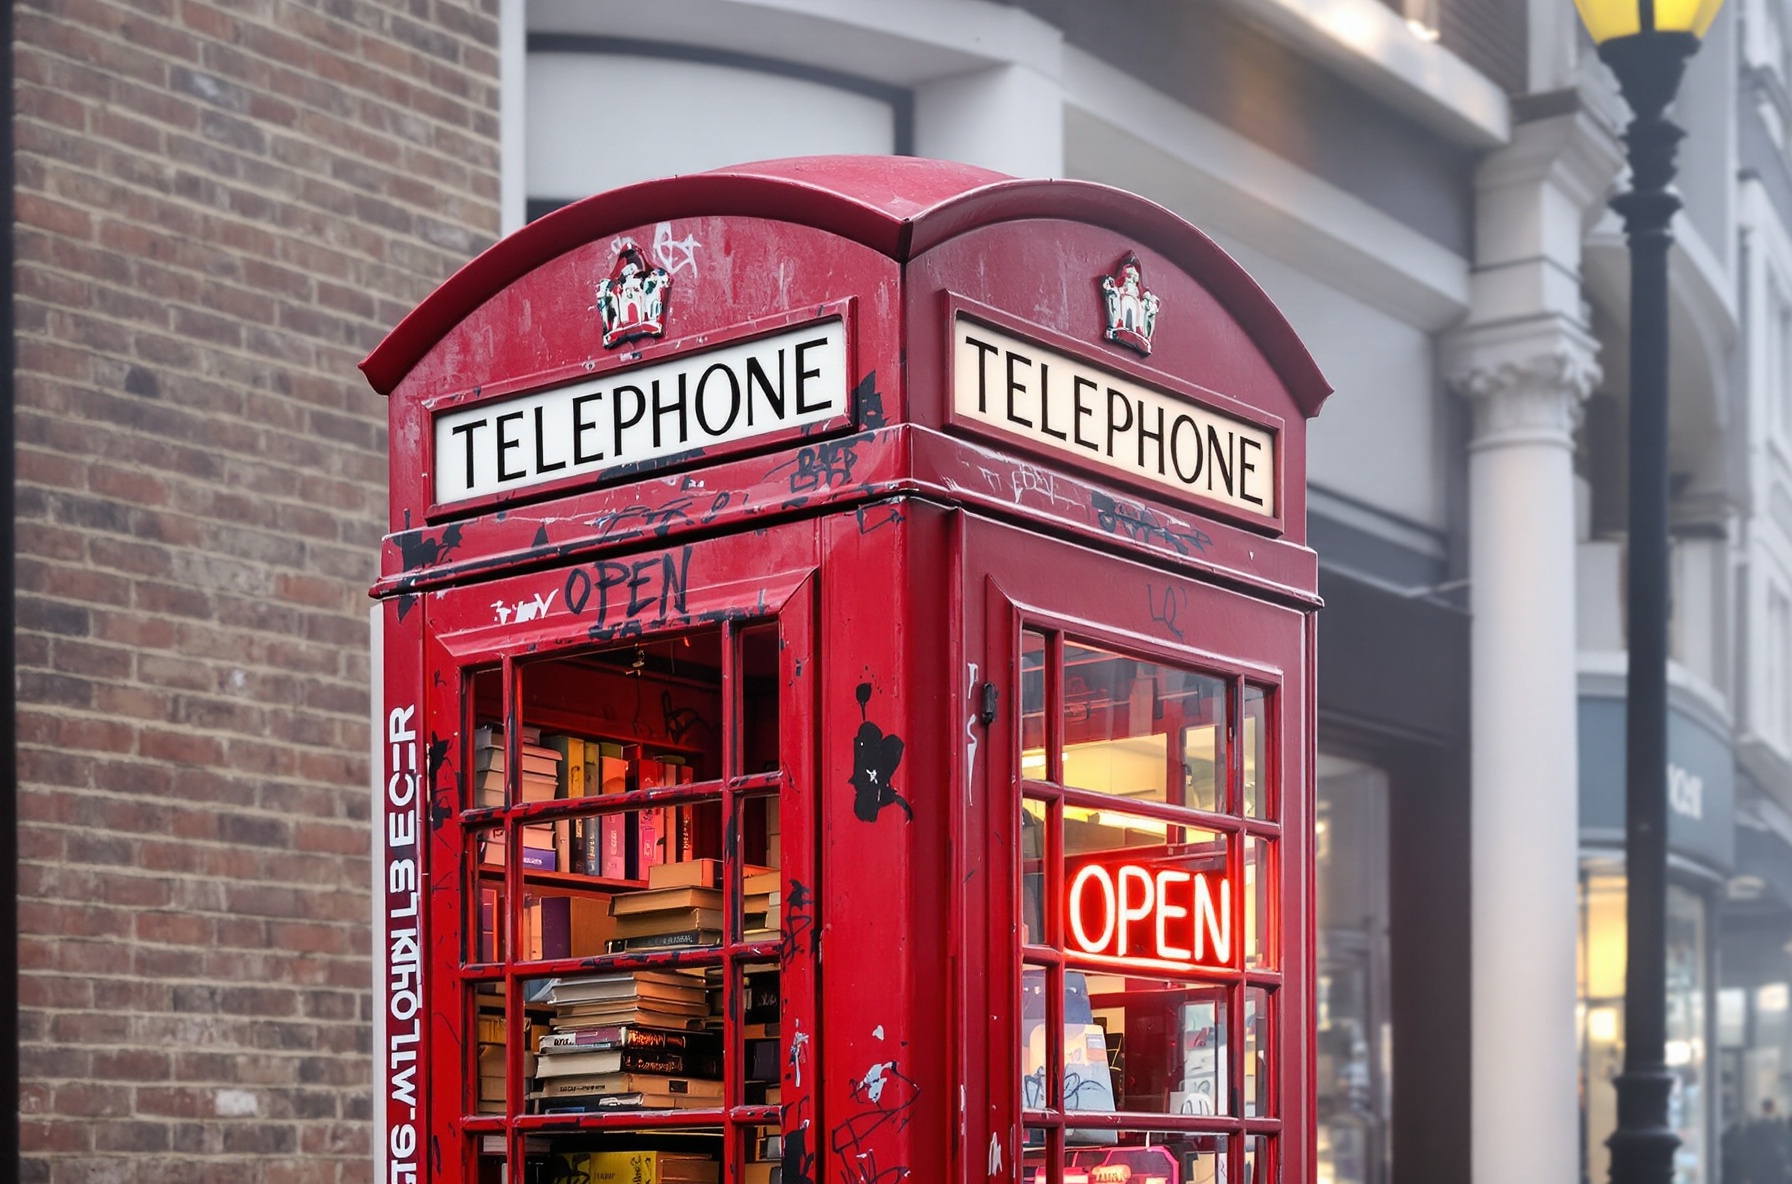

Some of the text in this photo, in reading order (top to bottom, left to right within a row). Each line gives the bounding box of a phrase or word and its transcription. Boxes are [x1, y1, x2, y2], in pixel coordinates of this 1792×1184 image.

[453, 336, 832, 489] TELEPHONE
[965, 335, 1264, 507] TELEPHONE
[564, 546, 693, 627] OPEN
[1069, 864, 1231, 964] OPEN
